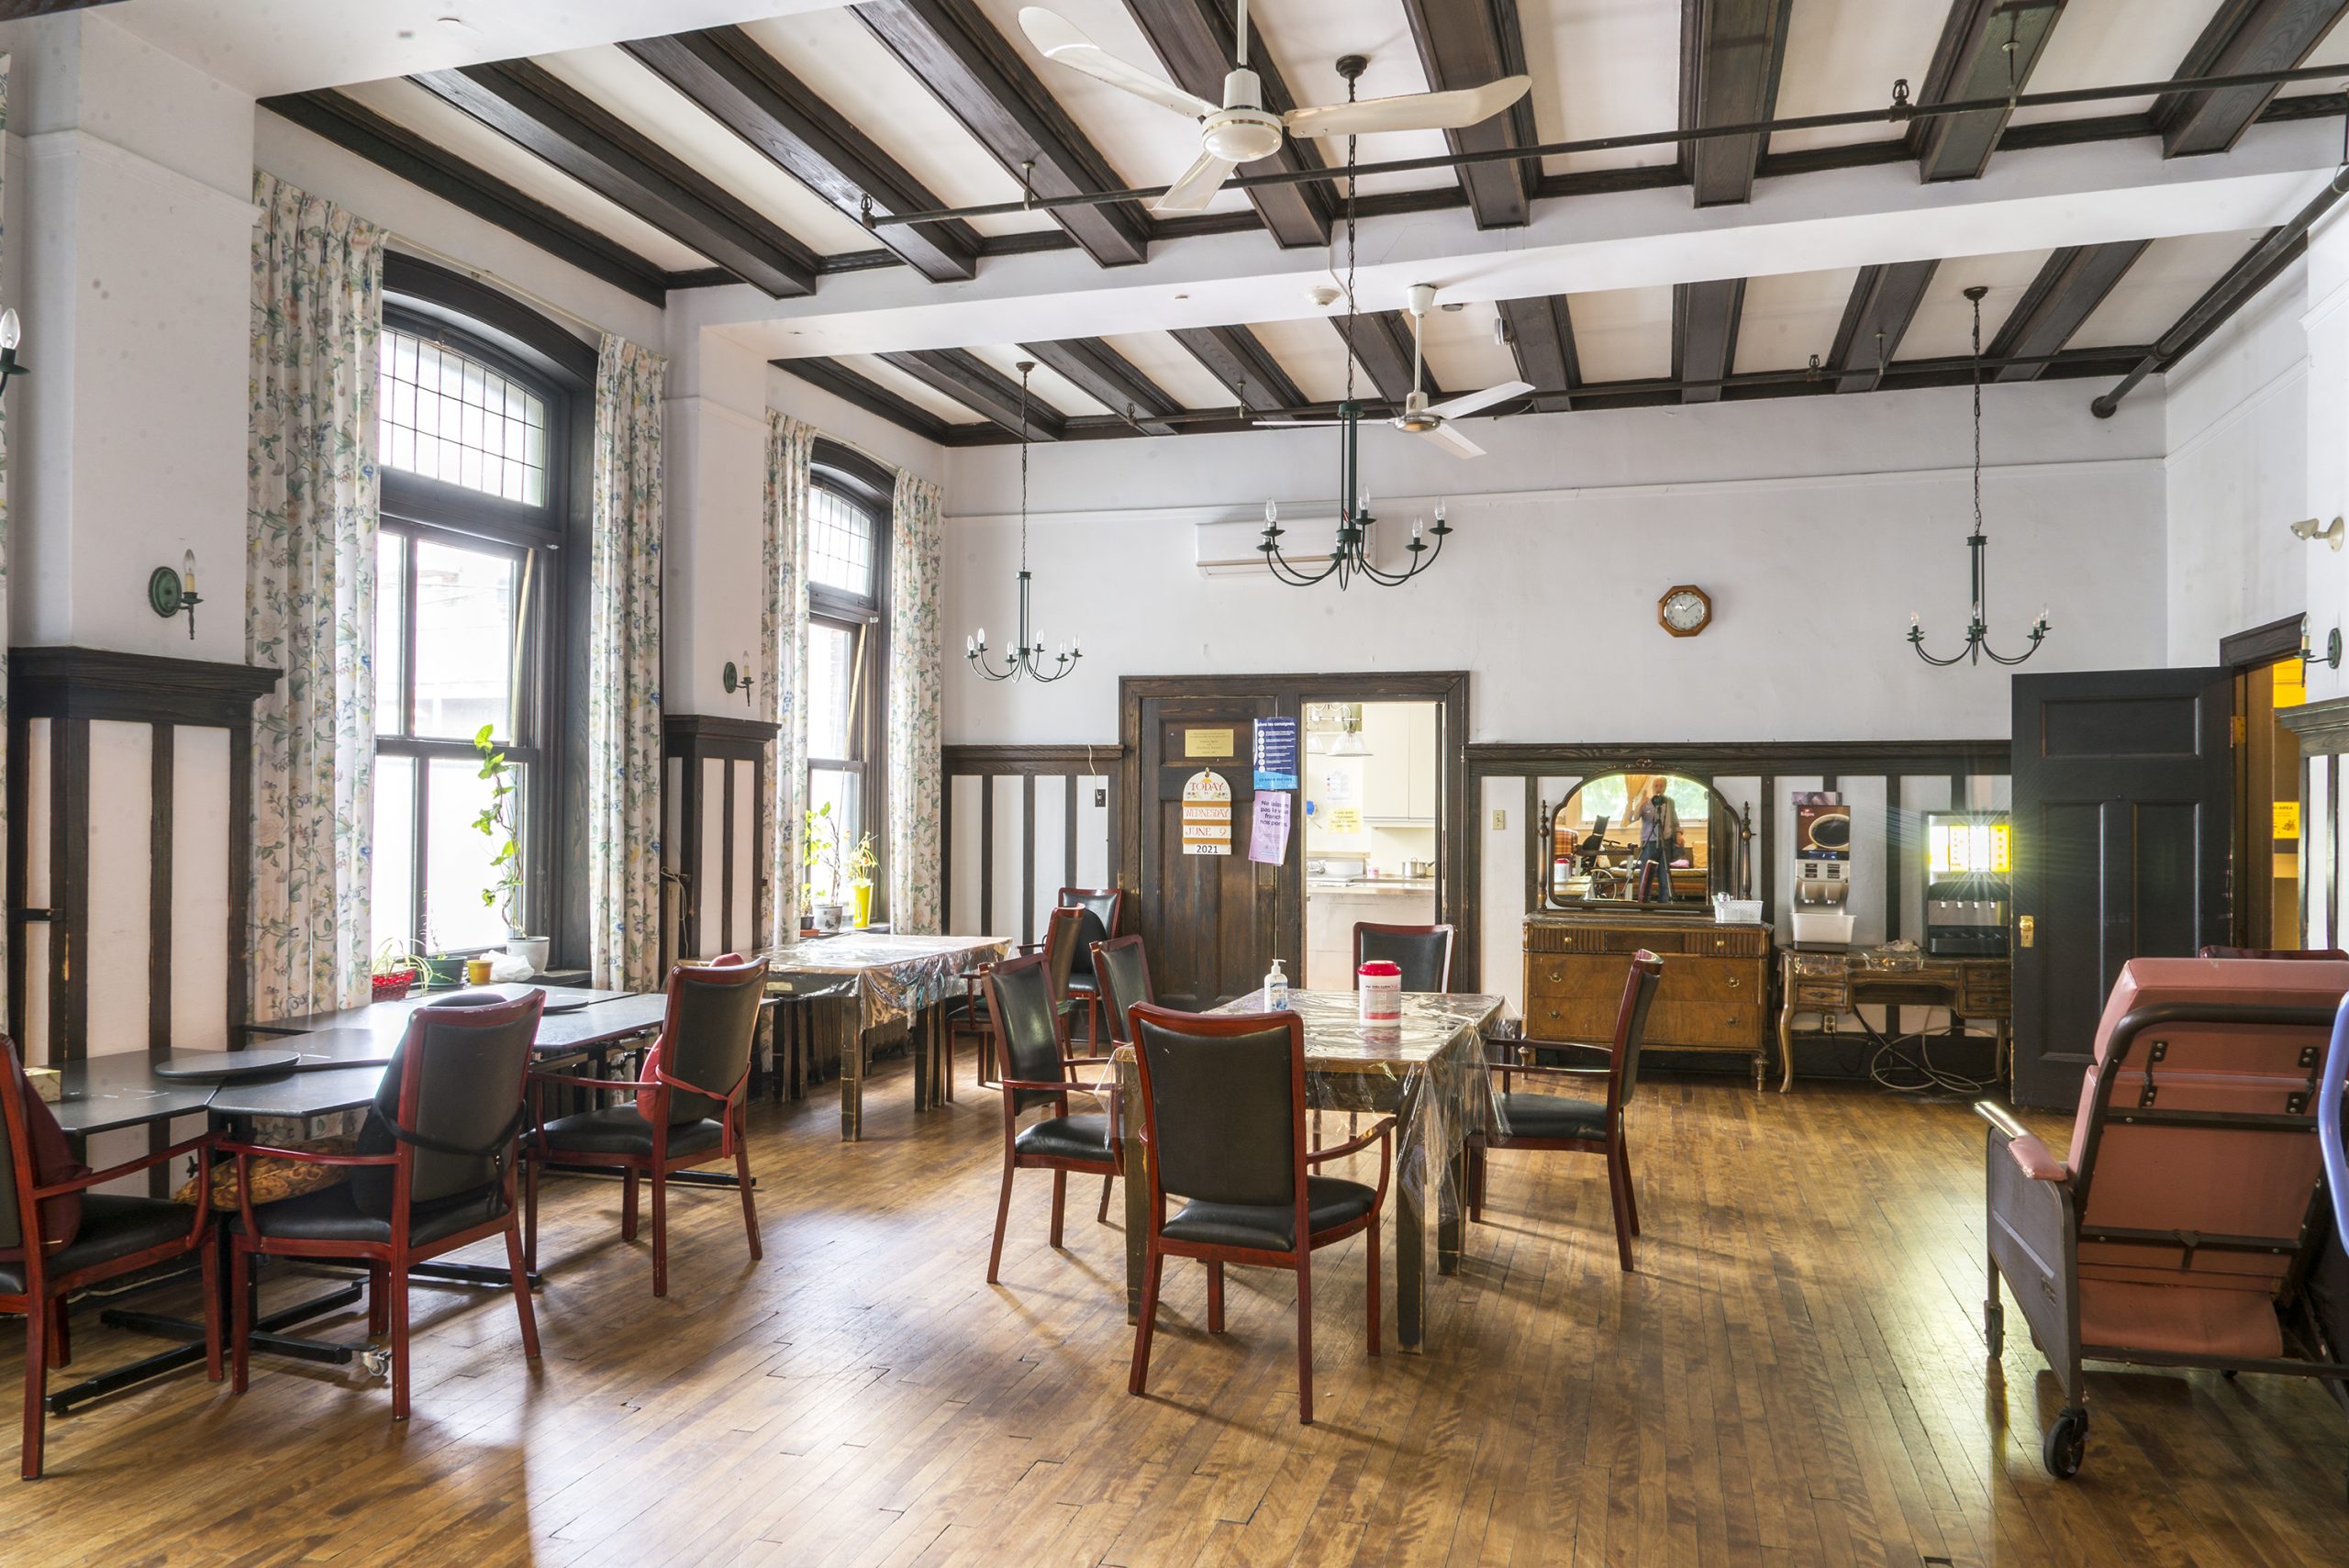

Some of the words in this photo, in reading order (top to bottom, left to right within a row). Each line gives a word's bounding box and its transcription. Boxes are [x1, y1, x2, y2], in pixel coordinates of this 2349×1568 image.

[1190, 782, 1224, 792] TODAY
[1184, 808, 1230, 817] WEDNESDAY
[1186, 827, 1211, 836] JUNE
[1219, 827, 1227, 837] 9
[1197, 844, 1218, 853] 2021
